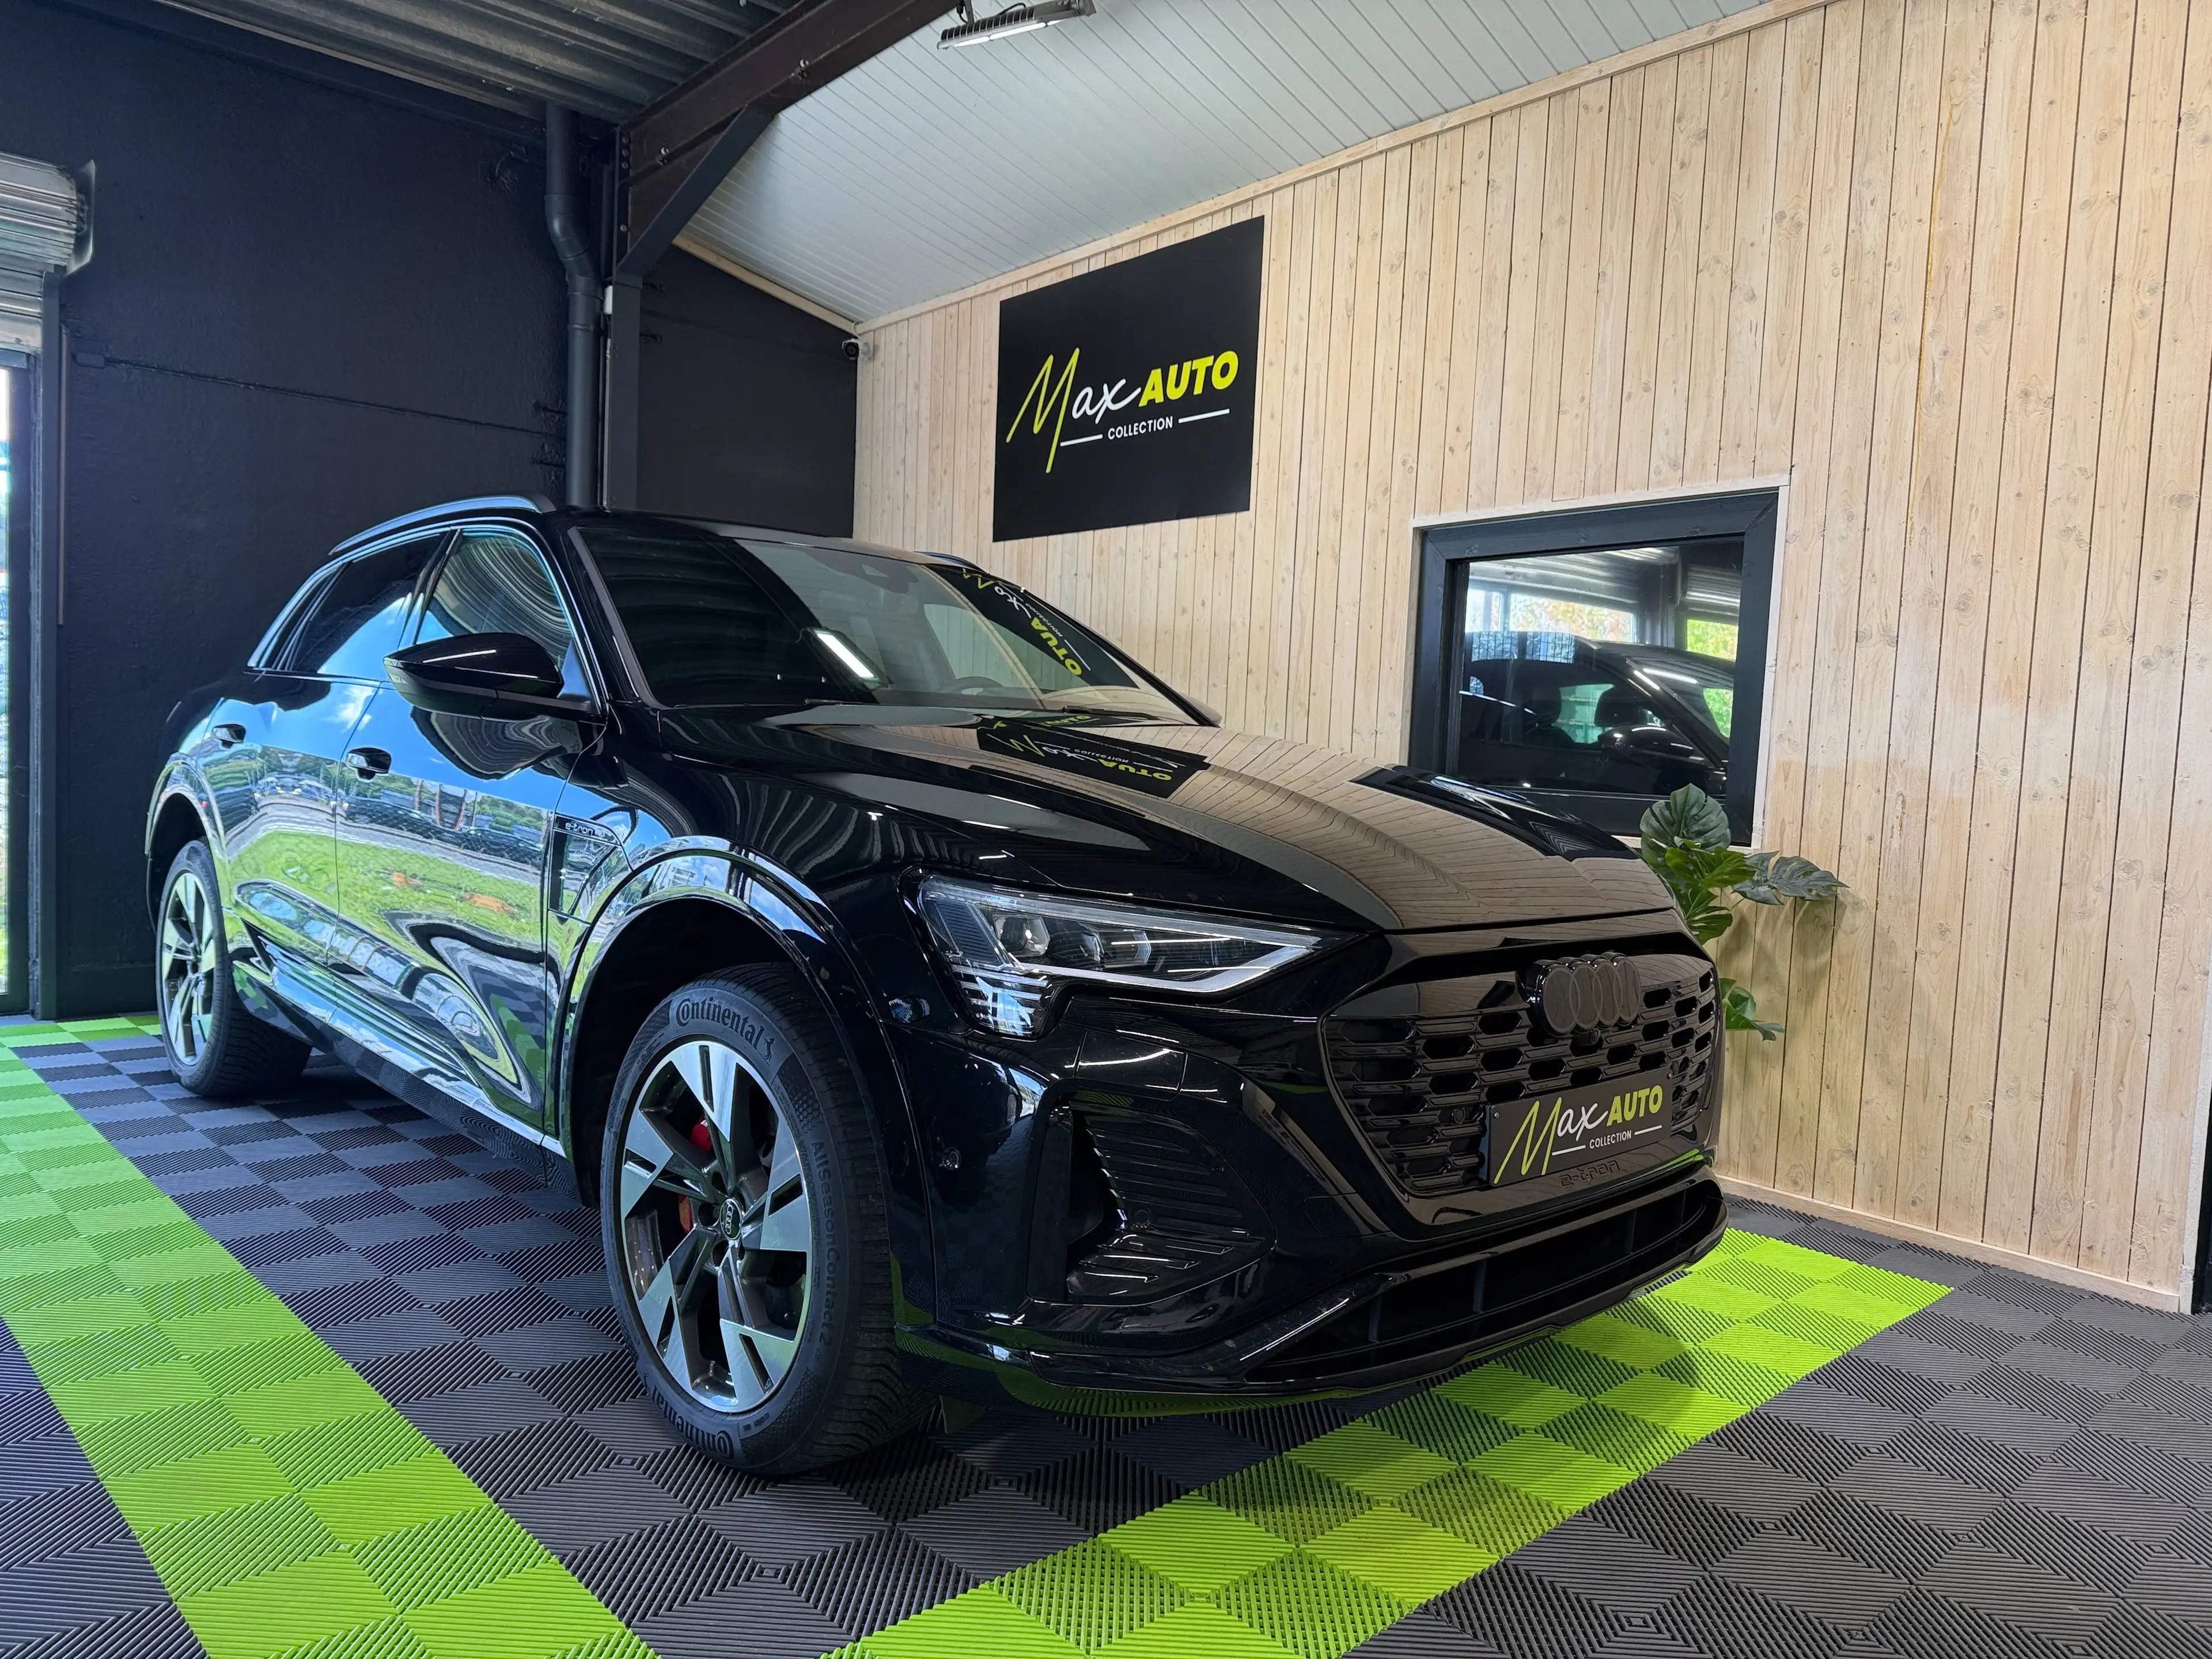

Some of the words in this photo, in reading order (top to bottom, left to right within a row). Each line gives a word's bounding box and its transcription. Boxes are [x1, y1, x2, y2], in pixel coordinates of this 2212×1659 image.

[1006, 347, 1141, 473] Max
[1138, 351, 1238, 407] AUTO
[1107, 415, 1173, 440] COLLECTION
[565, 822, 593, 836] e-tron
[676, 997, 765, 1050] Continental
[1494, 1097, 1608, 1184] Max
[1607, 1085, 1663, 1127] AUTO
[1589, 1129, 1632, 1150] COLLECTION
[1558, 1160, 1620, 1188] e-tron
